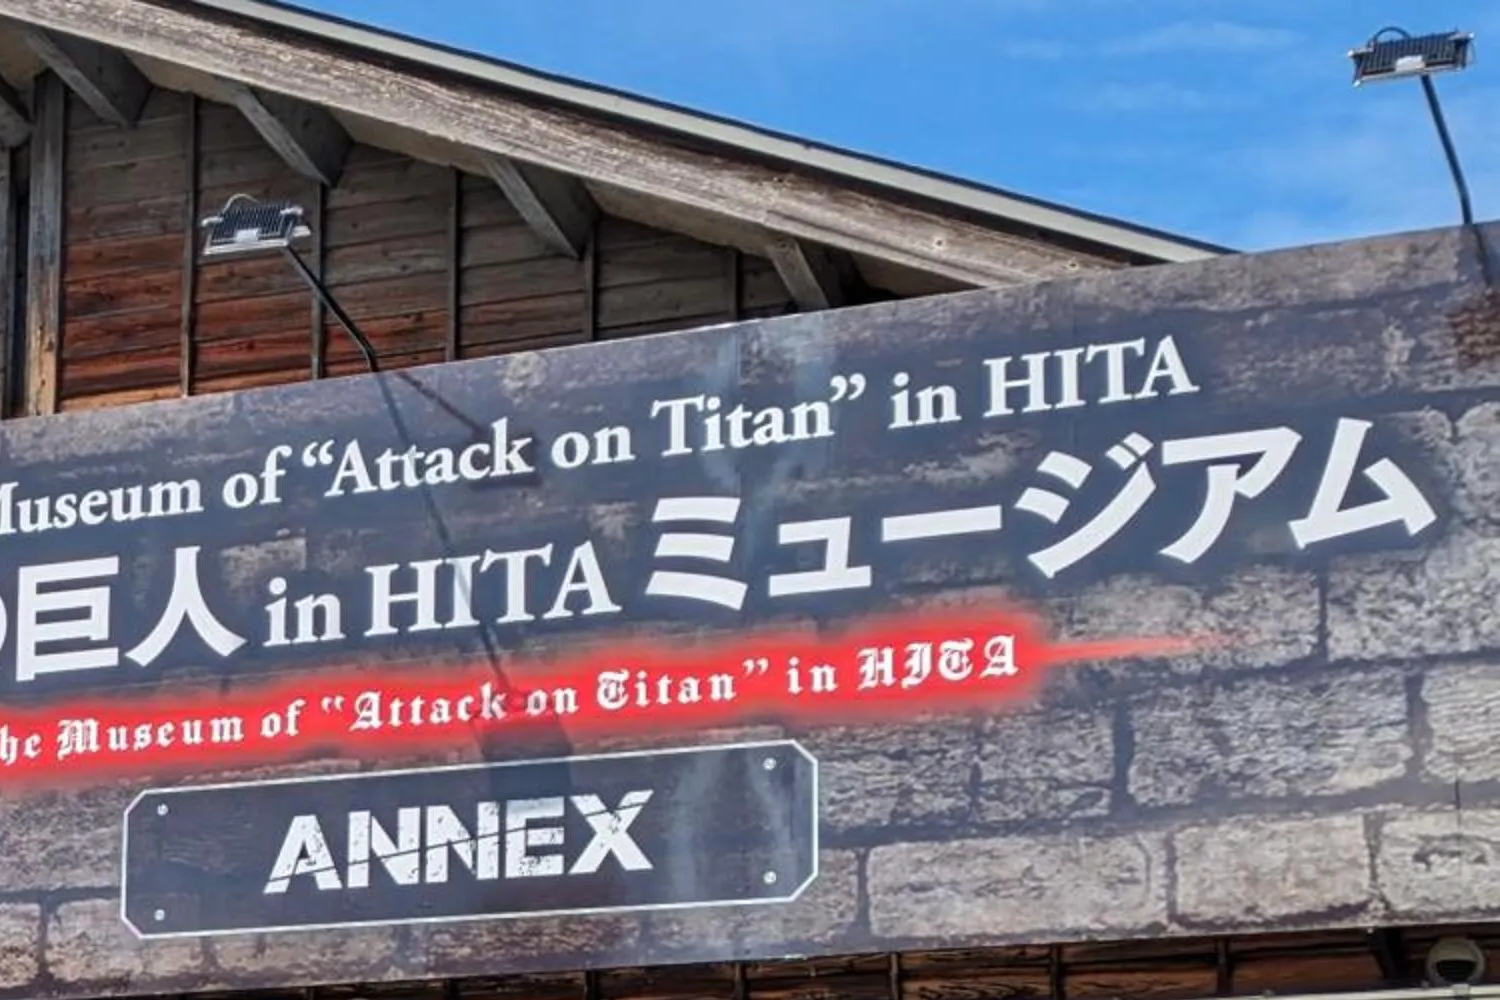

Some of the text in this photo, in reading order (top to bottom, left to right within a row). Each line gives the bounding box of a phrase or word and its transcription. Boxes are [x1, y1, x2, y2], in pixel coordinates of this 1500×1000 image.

[222, 445, 293, 509] of
[302, 417, 534, 498] “Attack
[551, 427, 635, 470] on
[651, 373, 867, 458] Titan”
[888, 371, 961, 430] in
[983, 335, 1200, 418] HITA
[262, 576, 345, 648] in
[363, 540, 622, 638] HITA
[645, 417, 1439, 611] ミュージアム
[56, 715, 245, 760] Museum
[260, 698, 307, 738] of
[321, 683, 506, 730] “Attack
[526, 687, 579, 716] on
[596, 659, 769, 710] Titan”
[786, 657, 837, 695] in
[857, 634, 1018, 690] HITA
[263, 789, 654, 895] ANNEX
